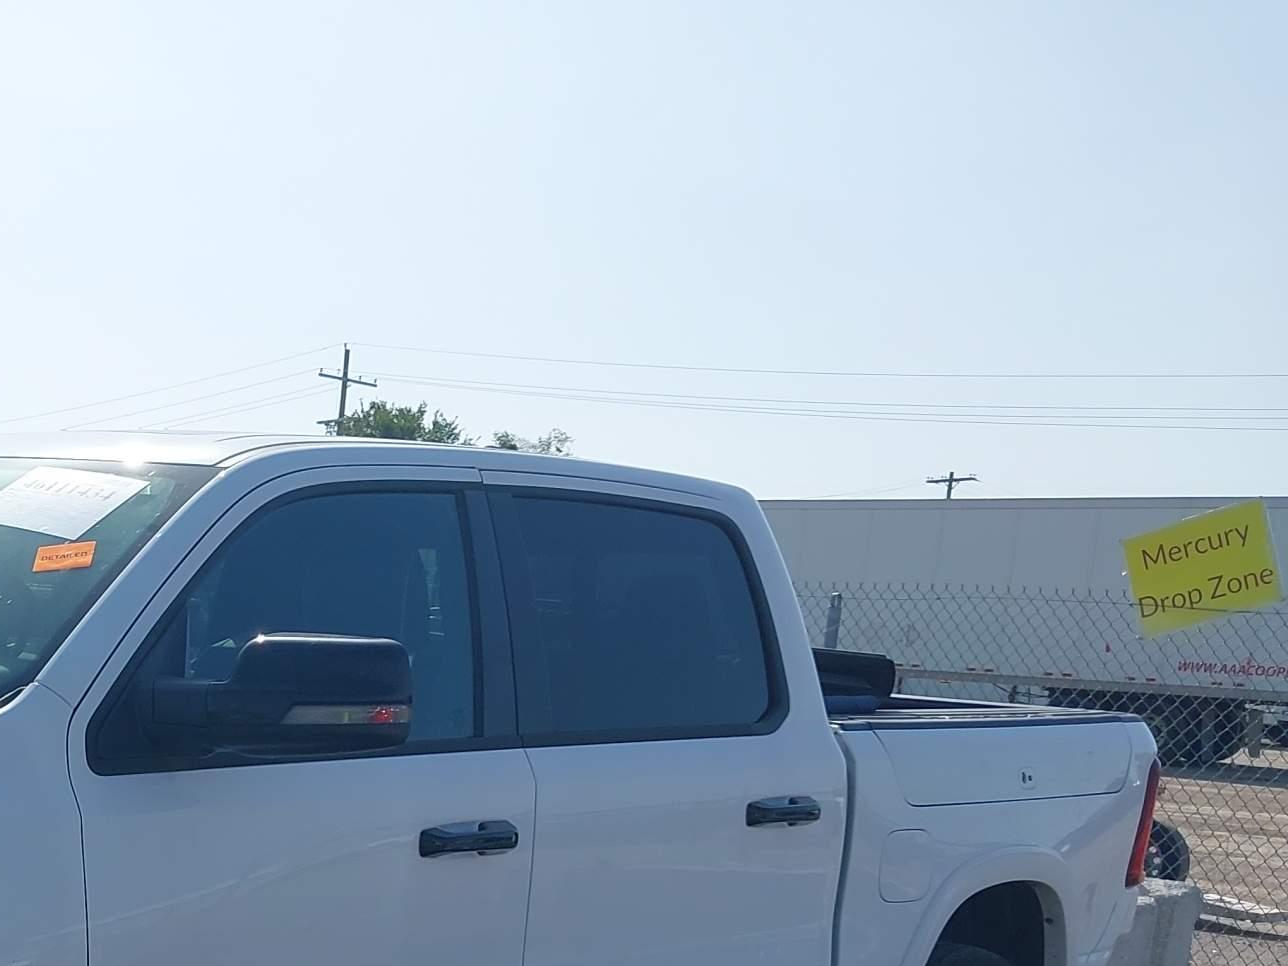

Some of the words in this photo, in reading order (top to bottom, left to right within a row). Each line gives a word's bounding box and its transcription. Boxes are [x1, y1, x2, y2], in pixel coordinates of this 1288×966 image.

[1141, 524, 1249, 570] Mercury
[1139, 588, 1203, 618] Drop
[1208, 568, 1274, 599] Zone
[1178, 661, 1288, 678] WWW.AAACOOP
